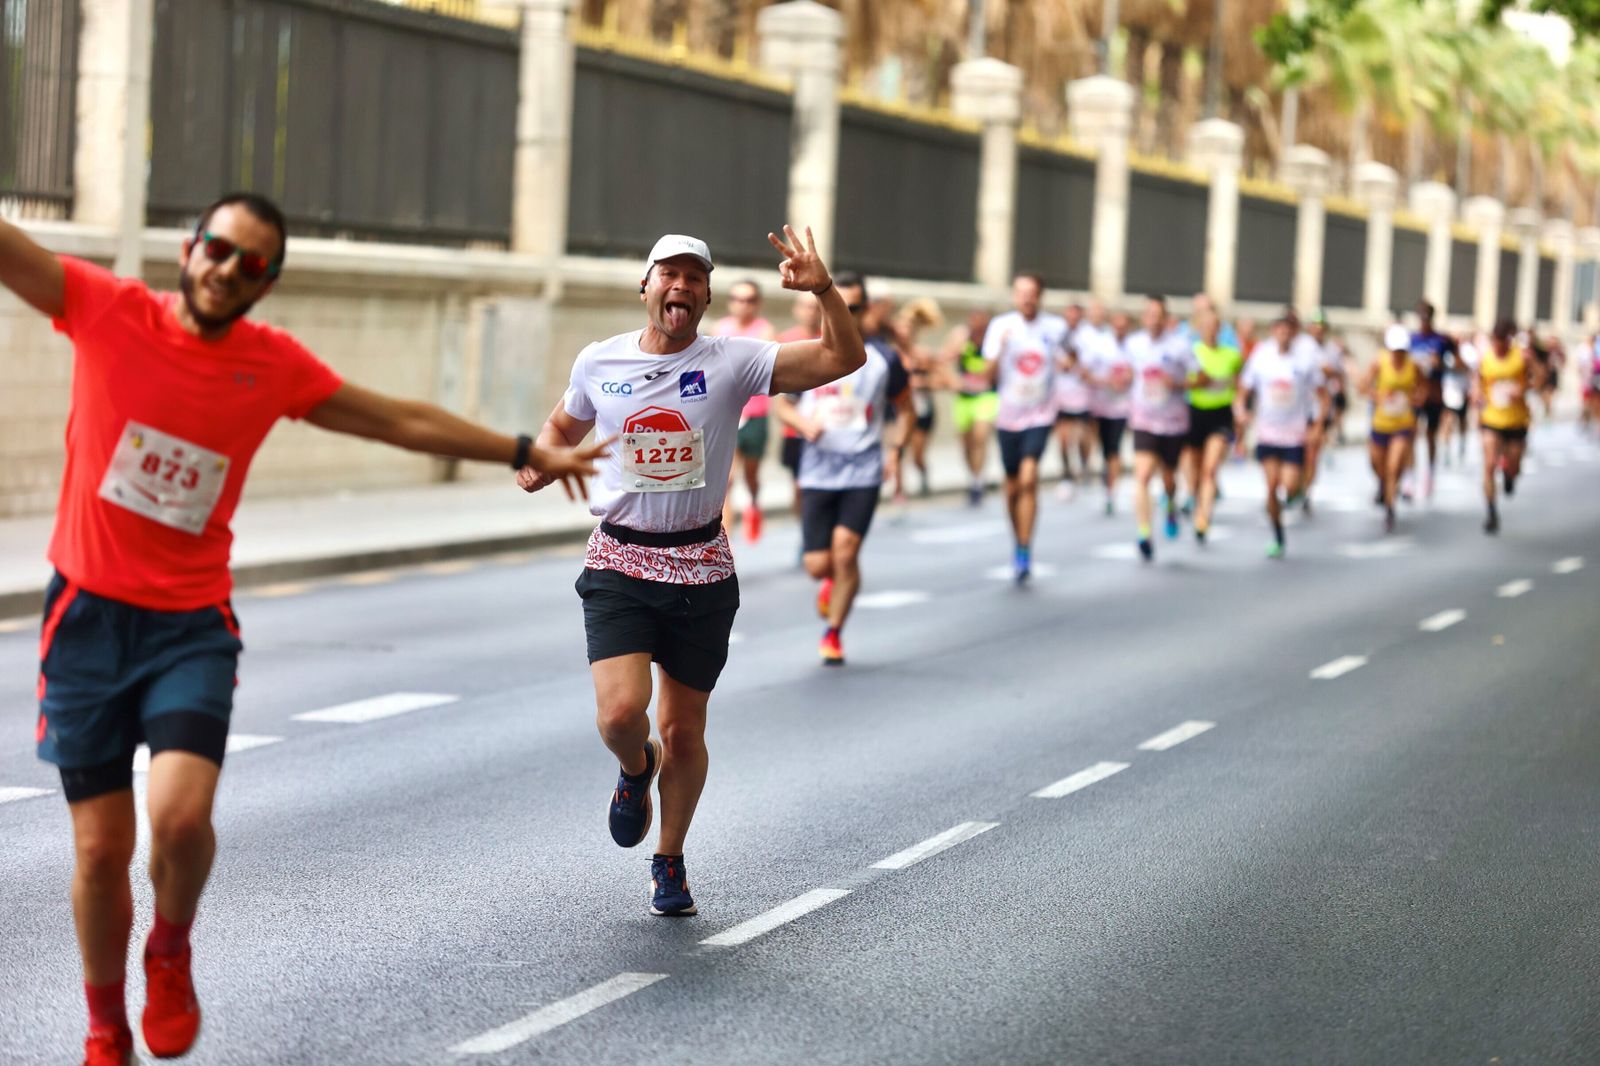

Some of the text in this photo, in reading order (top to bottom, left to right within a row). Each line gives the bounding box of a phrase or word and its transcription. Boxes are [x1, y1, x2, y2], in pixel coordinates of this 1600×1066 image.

[680, 382, 702, 396] AXA
[634, 446, 693, 464] 1272
[141, 451, 200, 491] 873
